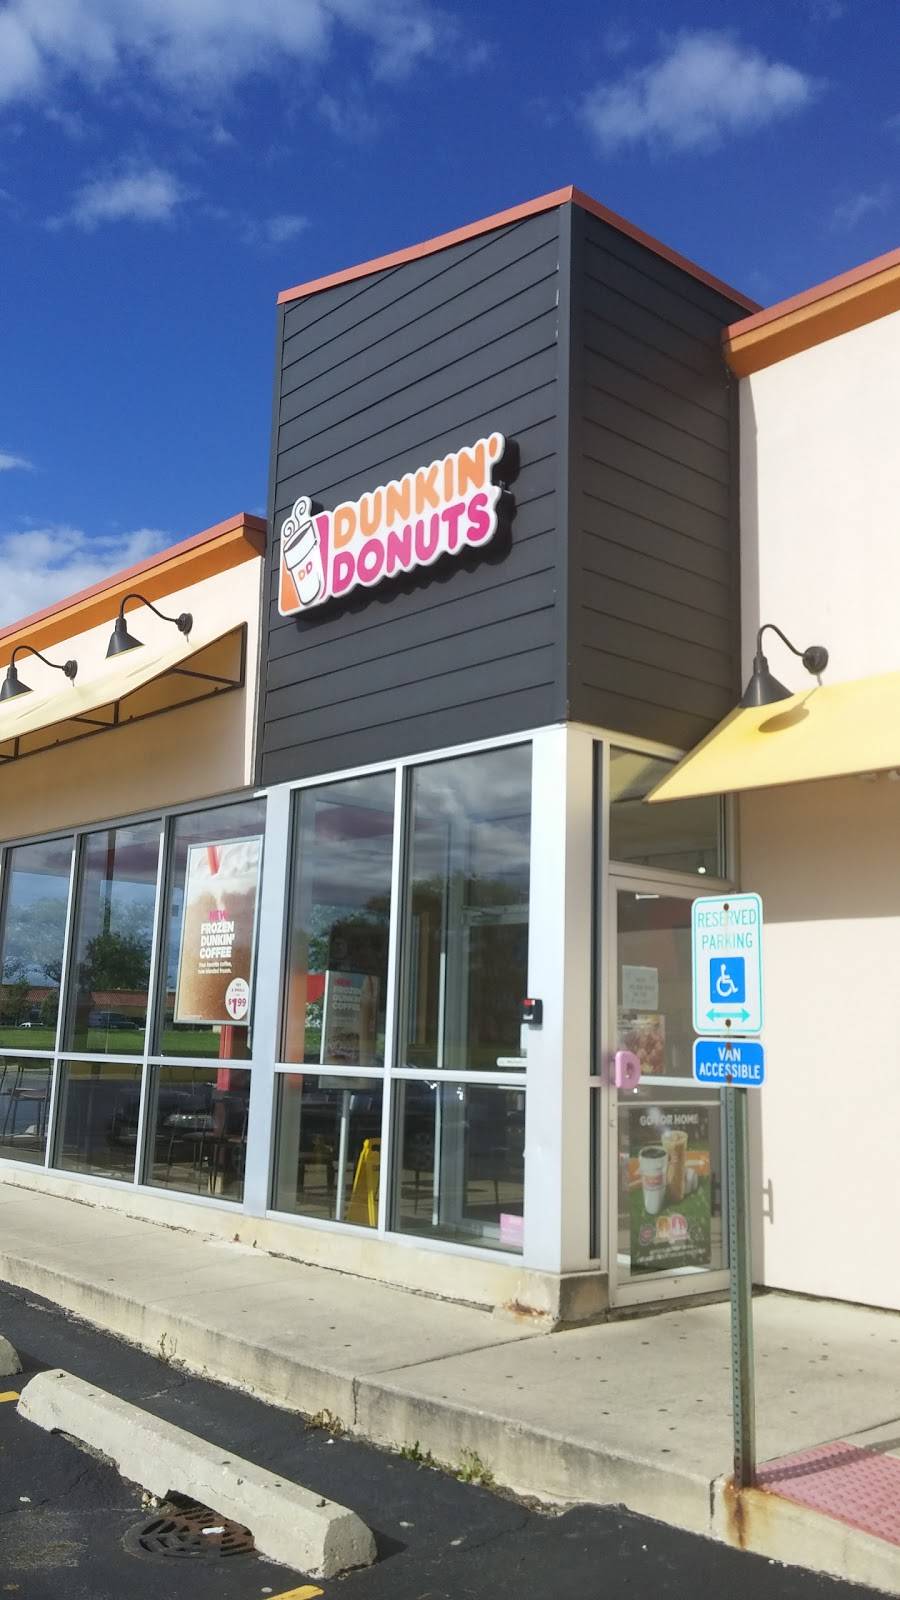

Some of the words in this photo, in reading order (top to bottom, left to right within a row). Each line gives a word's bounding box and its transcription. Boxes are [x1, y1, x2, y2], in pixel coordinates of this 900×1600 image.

[333, 436, 499, 549] DUNKIN'
[331, 492, 491, 594] DONUTS
[200, 920, 235, 934] FROZEN
[697, 908, 757, 928] RESERVED
[200, 933, 235, 947] DUNKIN'
[701, 931, 753, 950] PARKING
[199, 946, 232, 959] COFFEE
[717, 1046, 741, 1062] VAN
[699, 1061, 761, 1080] ACCESSIBLE
